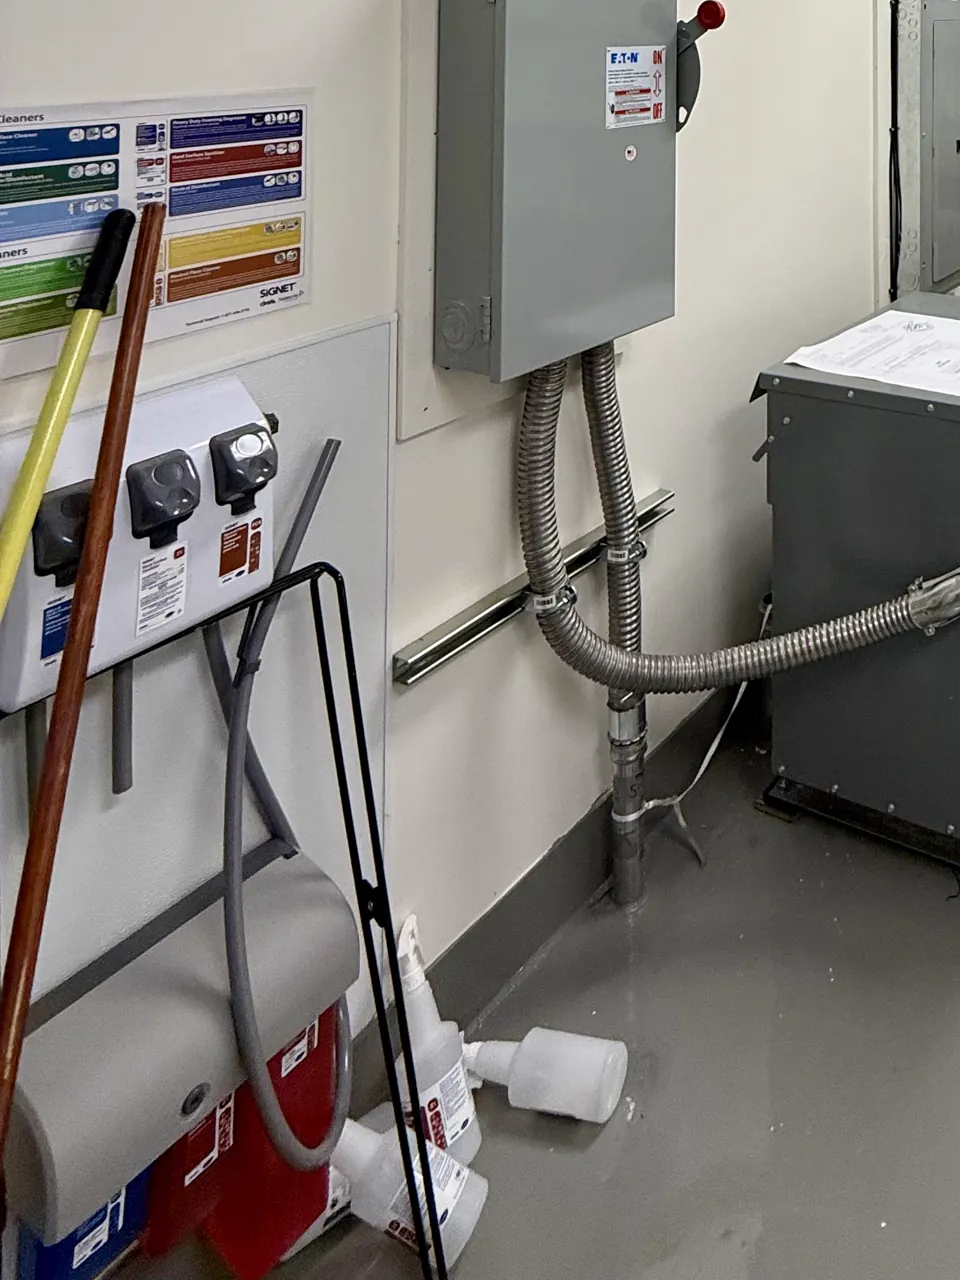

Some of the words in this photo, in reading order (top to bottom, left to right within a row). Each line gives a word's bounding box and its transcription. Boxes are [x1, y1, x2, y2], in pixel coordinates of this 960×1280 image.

[611, 52, 638, 64] EATON
[653, 50, 662, 65] ON
[653, 102, 663, 120] OFF
[0, 247, 28, 259] ners
